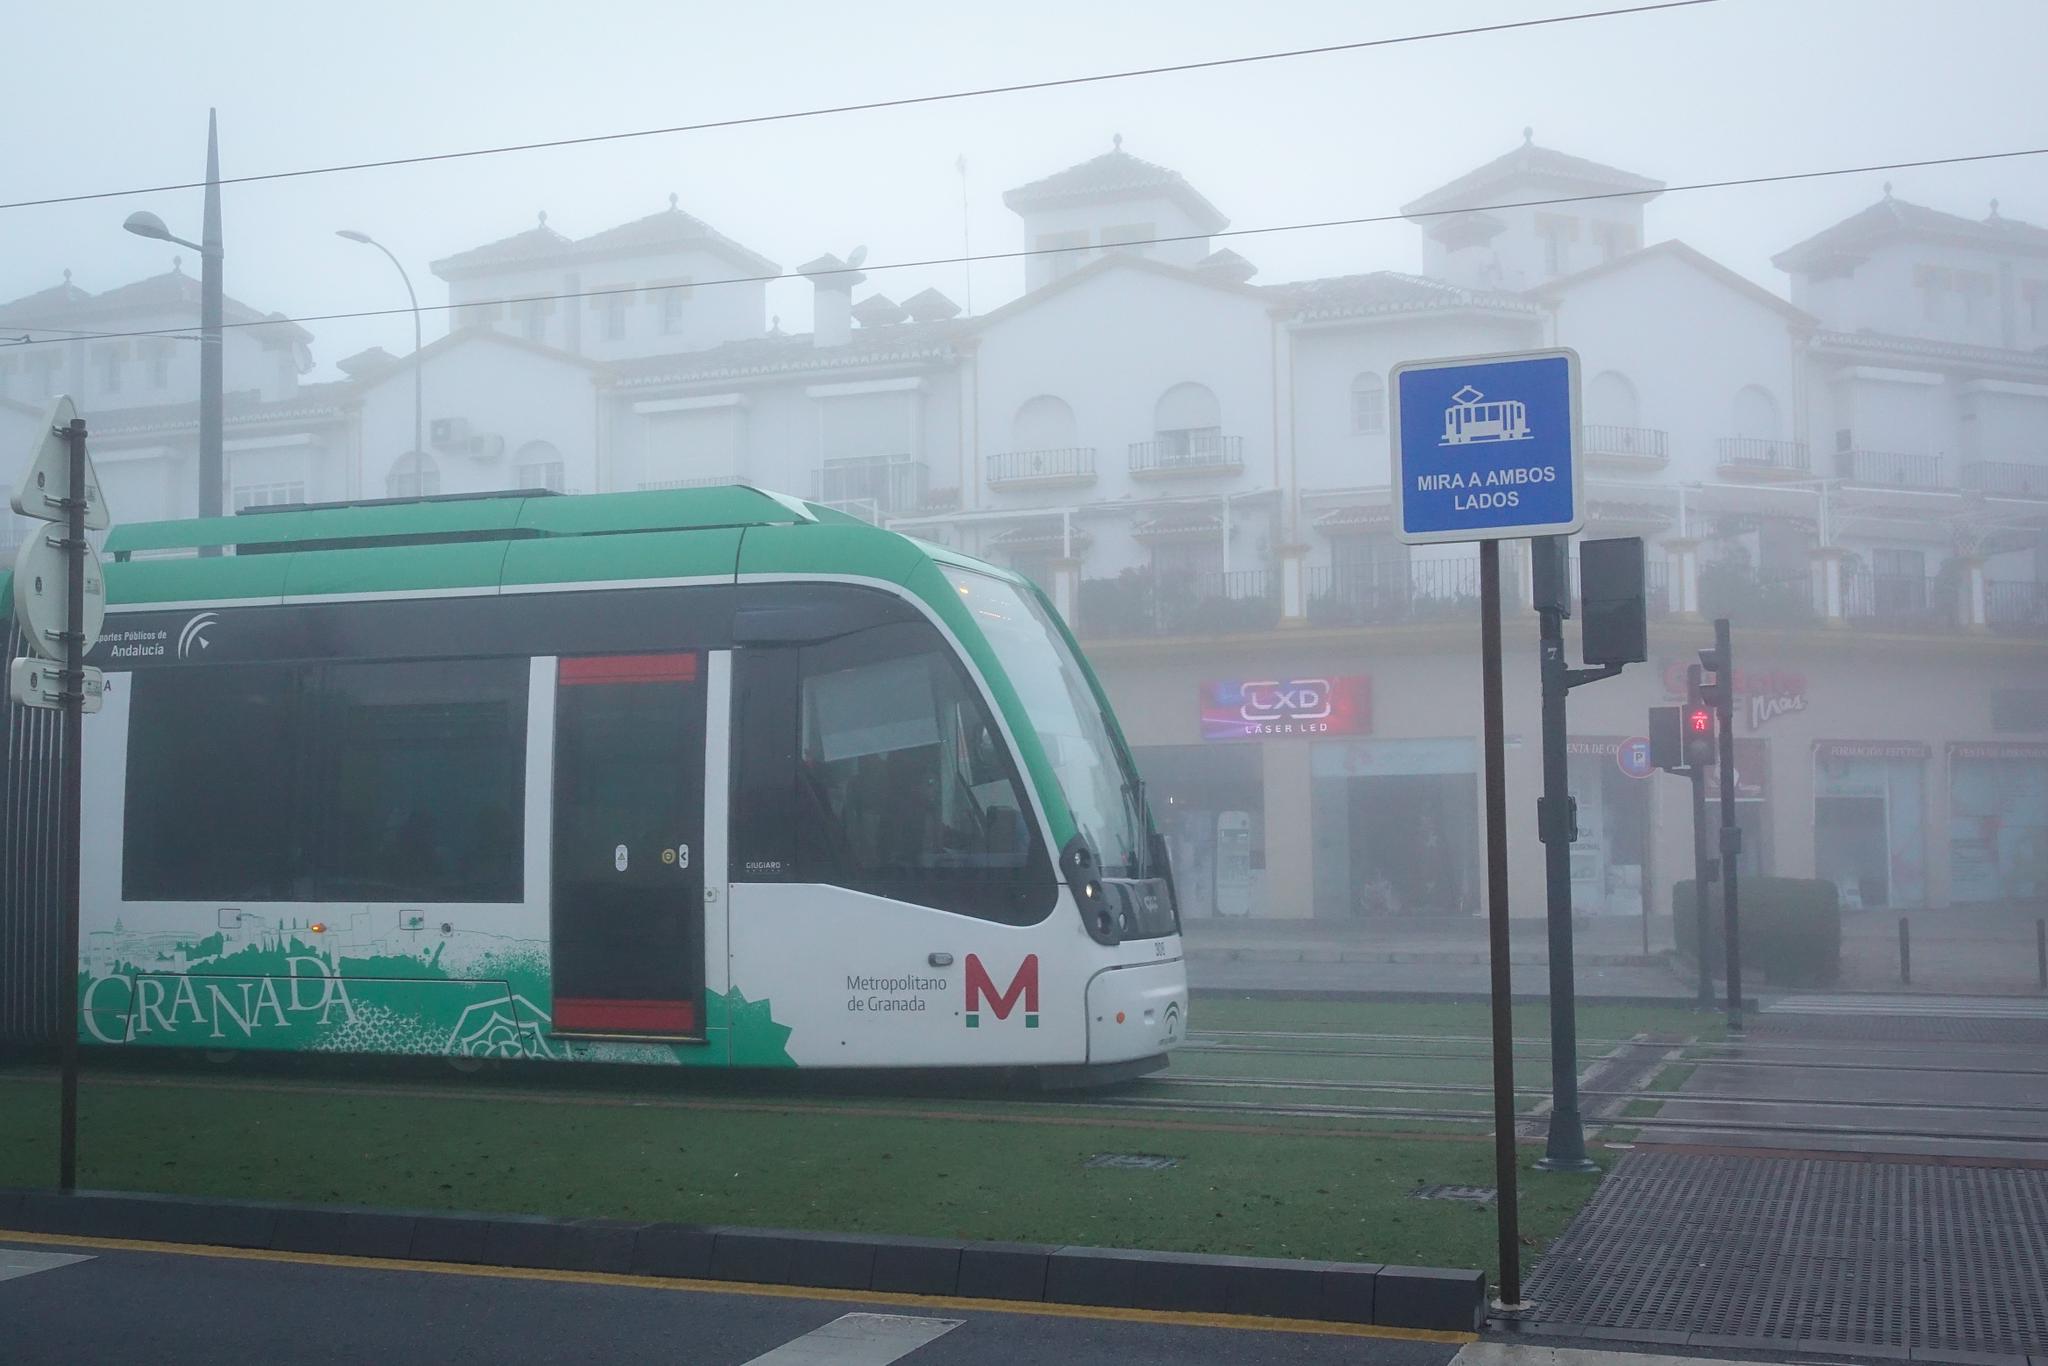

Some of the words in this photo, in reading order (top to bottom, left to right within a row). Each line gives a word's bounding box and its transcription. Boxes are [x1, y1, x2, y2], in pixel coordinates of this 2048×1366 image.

[1417, 473, 1465, 491] MIRA
[1468, 472, 1482, 487] A
[1485, 466, 1556, 487] AMBOS
[1454, 491, 1520, 511] LADOS
[124, 630, 156, 641] Públicos
[157, 630, 168, 640] de
[111, 643, 165, 657] Andalucía
[1252, 689, 1320, 710] LXD
[1300, 722, 1328, 733] LED
[1566, 743, 1591, 754] ENTA
[846, 974, 947, 994] Metropolitano
[83, 955, 359, 1044] GRANADA
[847, 996, 865, 1012] de
[867, 995, 926, 1012] Granada
